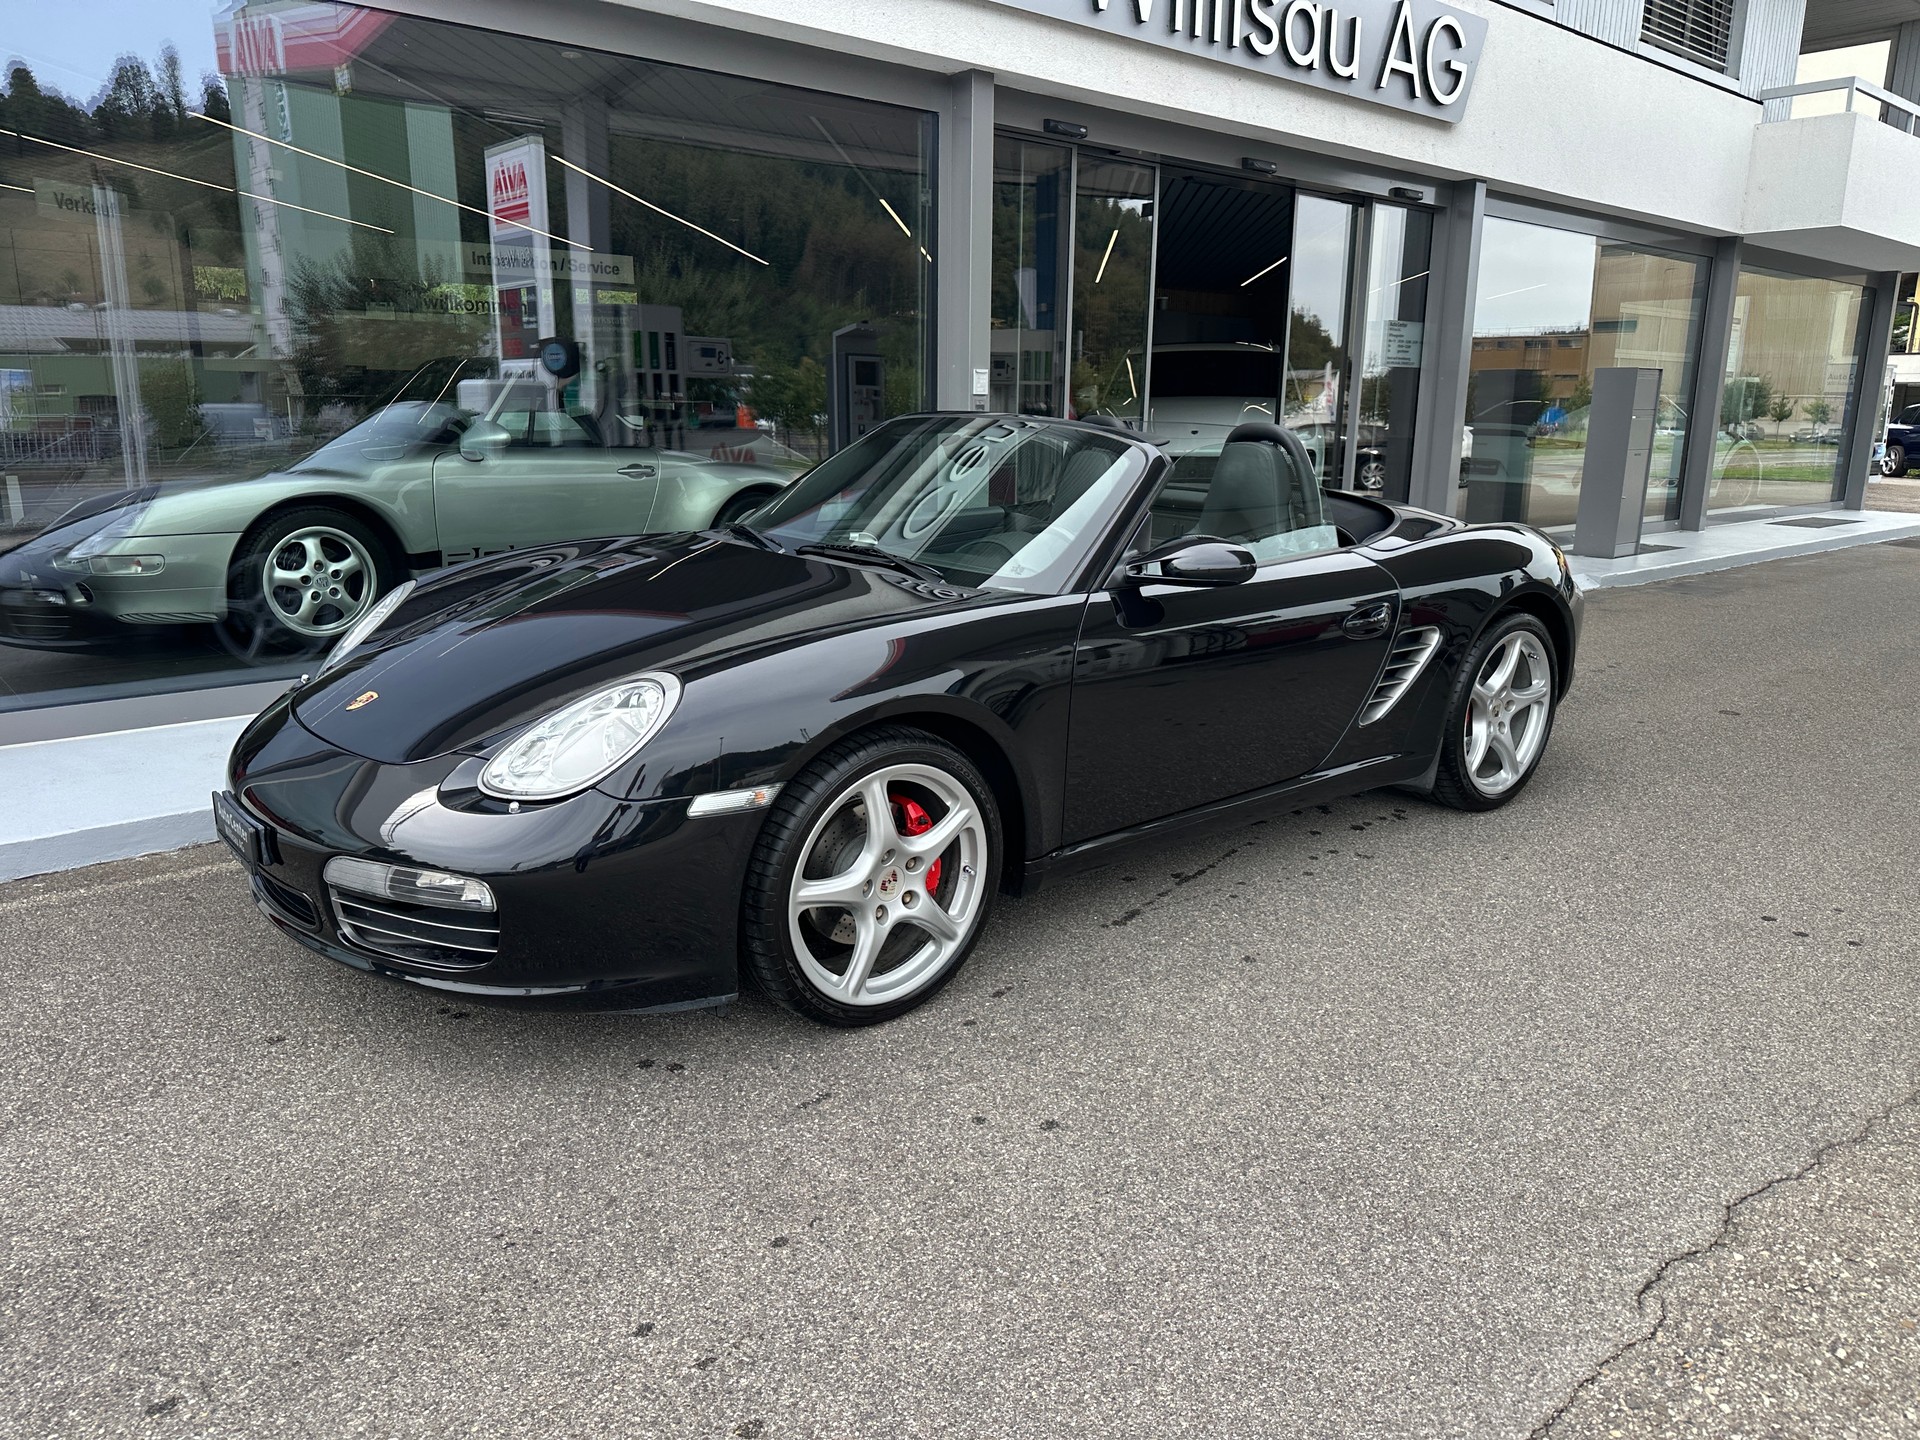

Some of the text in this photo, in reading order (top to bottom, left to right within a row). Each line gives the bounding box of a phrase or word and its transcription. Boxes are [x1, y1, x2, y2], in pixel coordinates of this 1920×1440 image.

[1094, 0, 1468, 106] isau AG
[568, 258, 621, 276] Service
